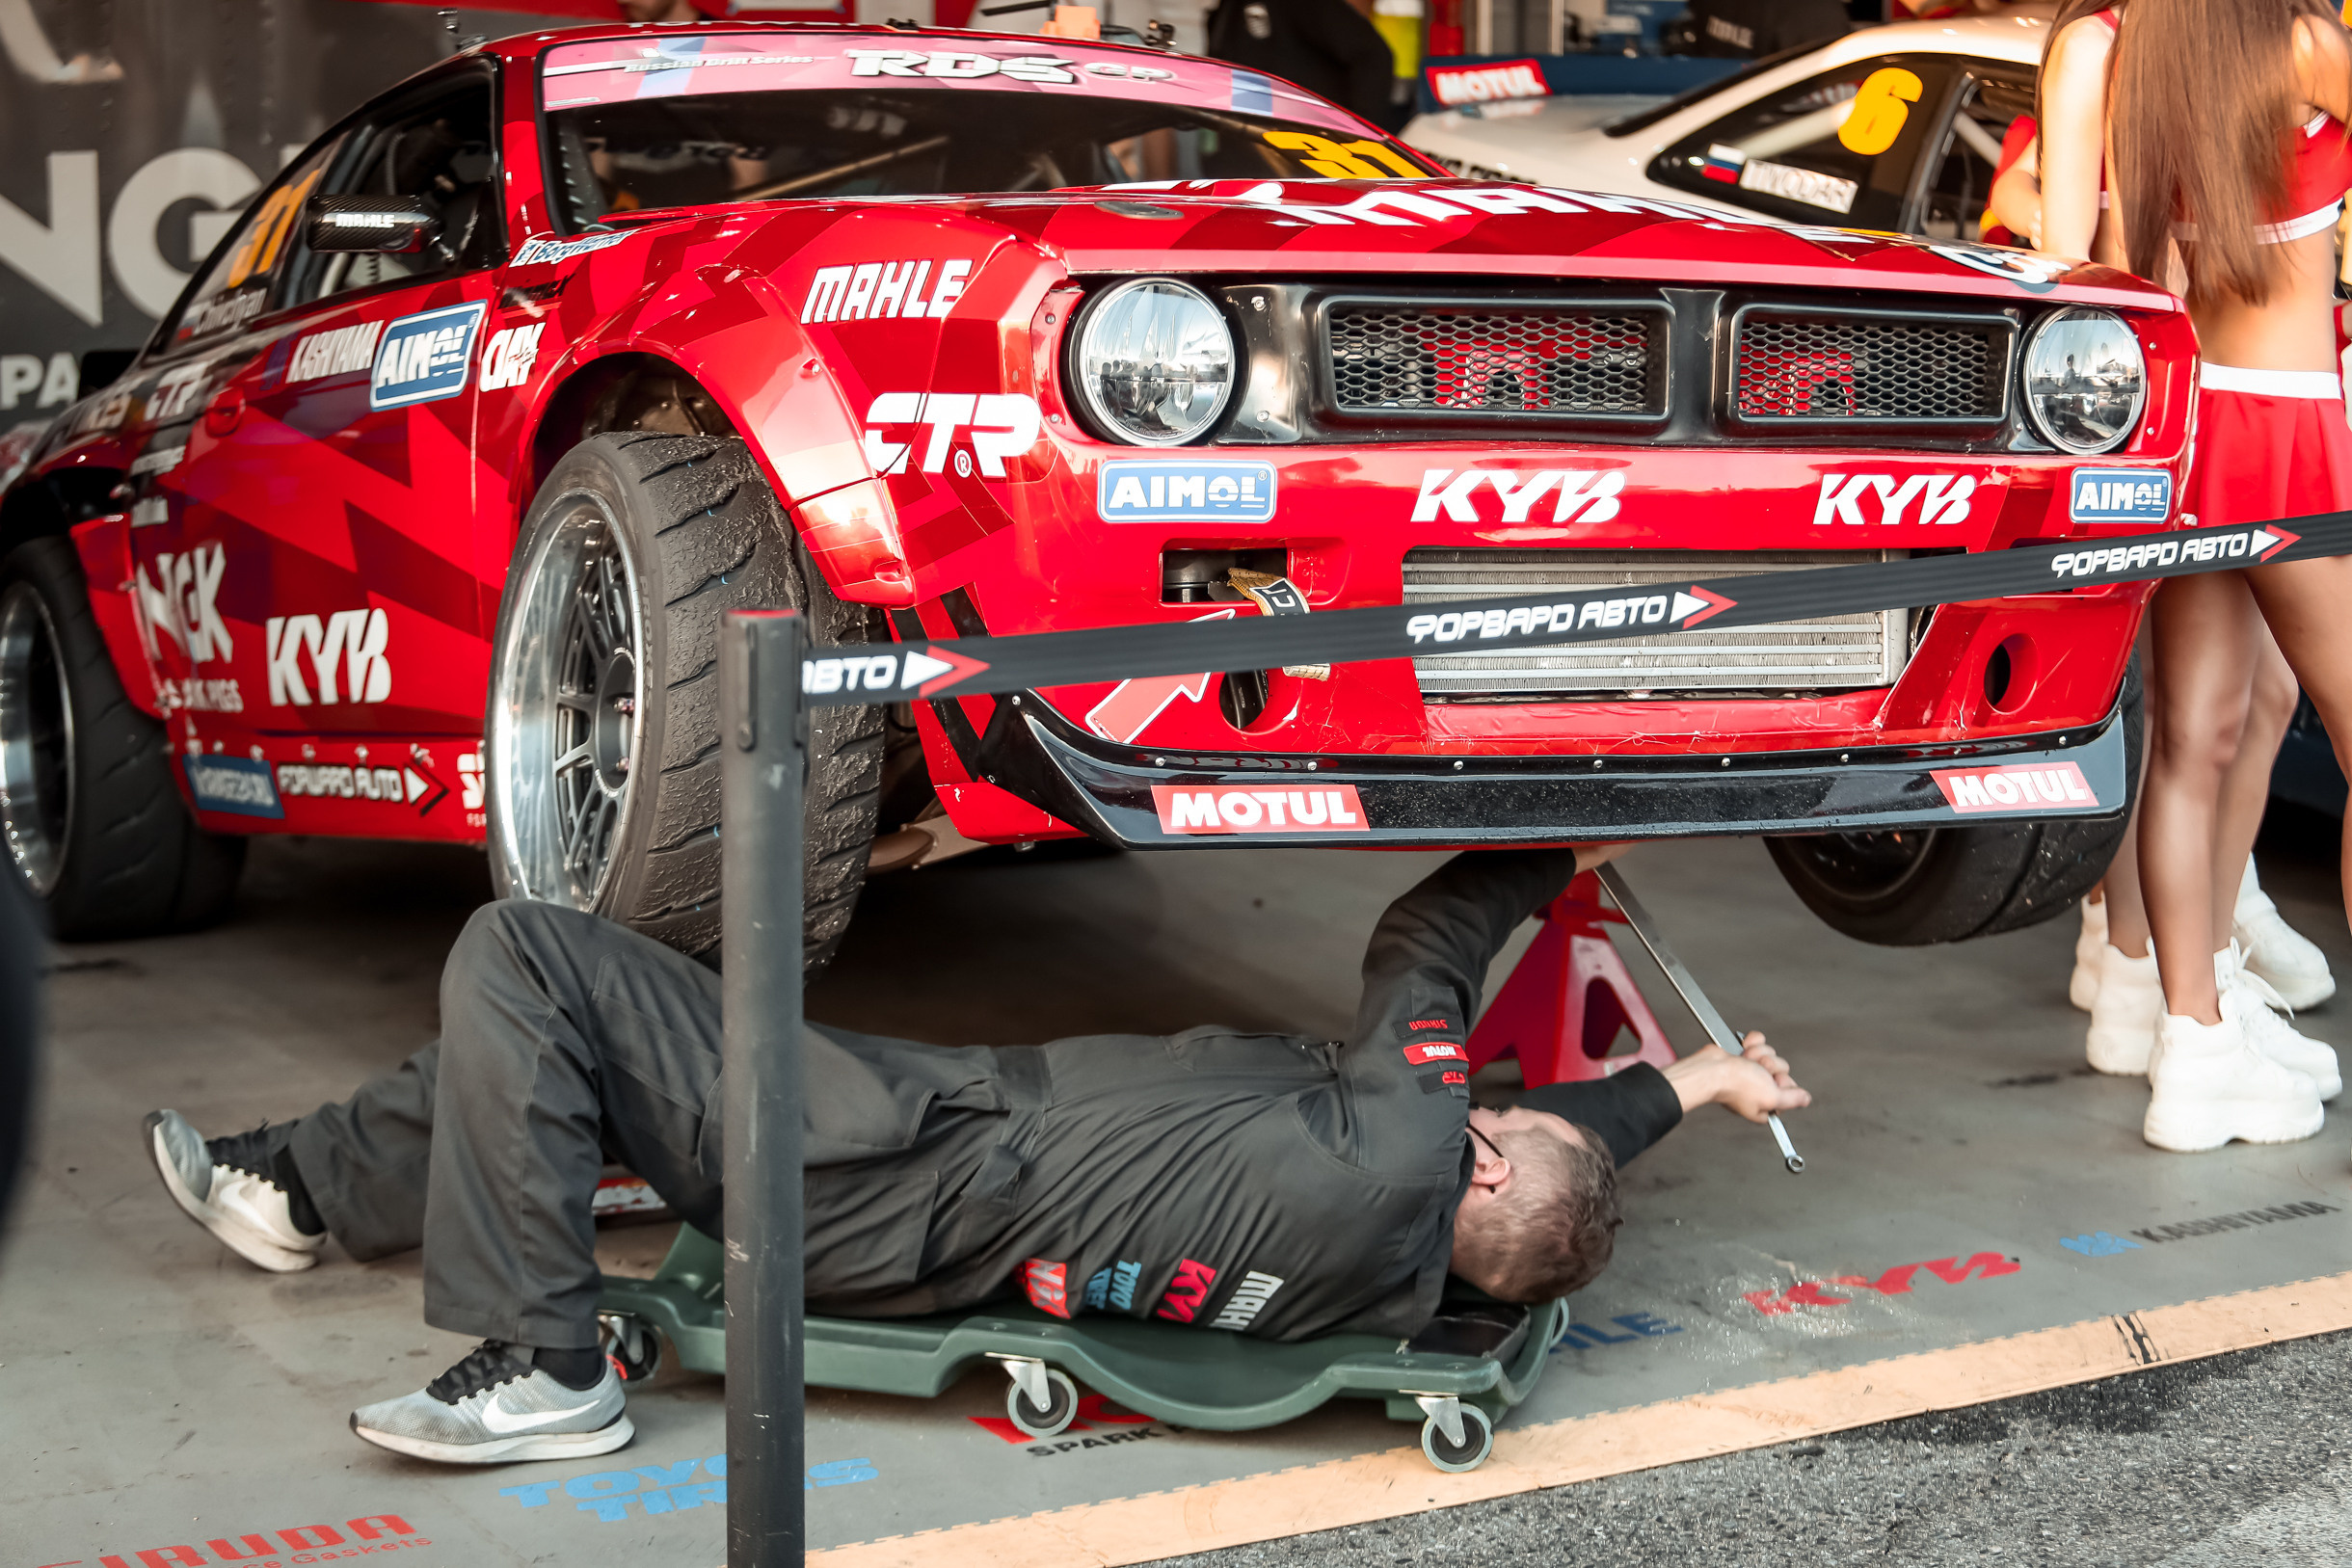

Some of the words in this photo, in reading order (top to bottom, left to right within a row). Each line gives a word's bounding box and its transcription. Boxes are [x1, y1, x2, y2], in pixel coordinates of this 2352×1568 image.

[705, 56, 751, 68] Drift
[750, 54, 815, 66] Series
[847, 49, 1075, 84] RDS
[1083, 62, 1172, 83] GP
[1435, 66, 1546, 103] MOTUL
[1838, 67, 1923, 155] 6
[1262, 131, 1430, 178] 31
[334, 213, 395, 228] MAHLE
[800, 259, 974, 325] MAHLE
[1109, 475, 1267, 509] AIMOL
[1410, 469, 1627, 523] KYB
[1812, 473, 1976, 525] KYB
[2075, 480, 2168, 512] AIMOL
[265, 607, 392, 706] KYB
[1949, 768, 2088, 809] MOTUL
[1171, 791, 1357, 828] MOTUL
[1422, 1045, 1457, 1058] MOTUL
[1109, 1259, 1142, 1311] TOYO
[1027, 1426, 1163, 1457] SPARK
[576, 1457, 880, 1523] TIRS
[291, 1536, 432, 1564] Gaskets
